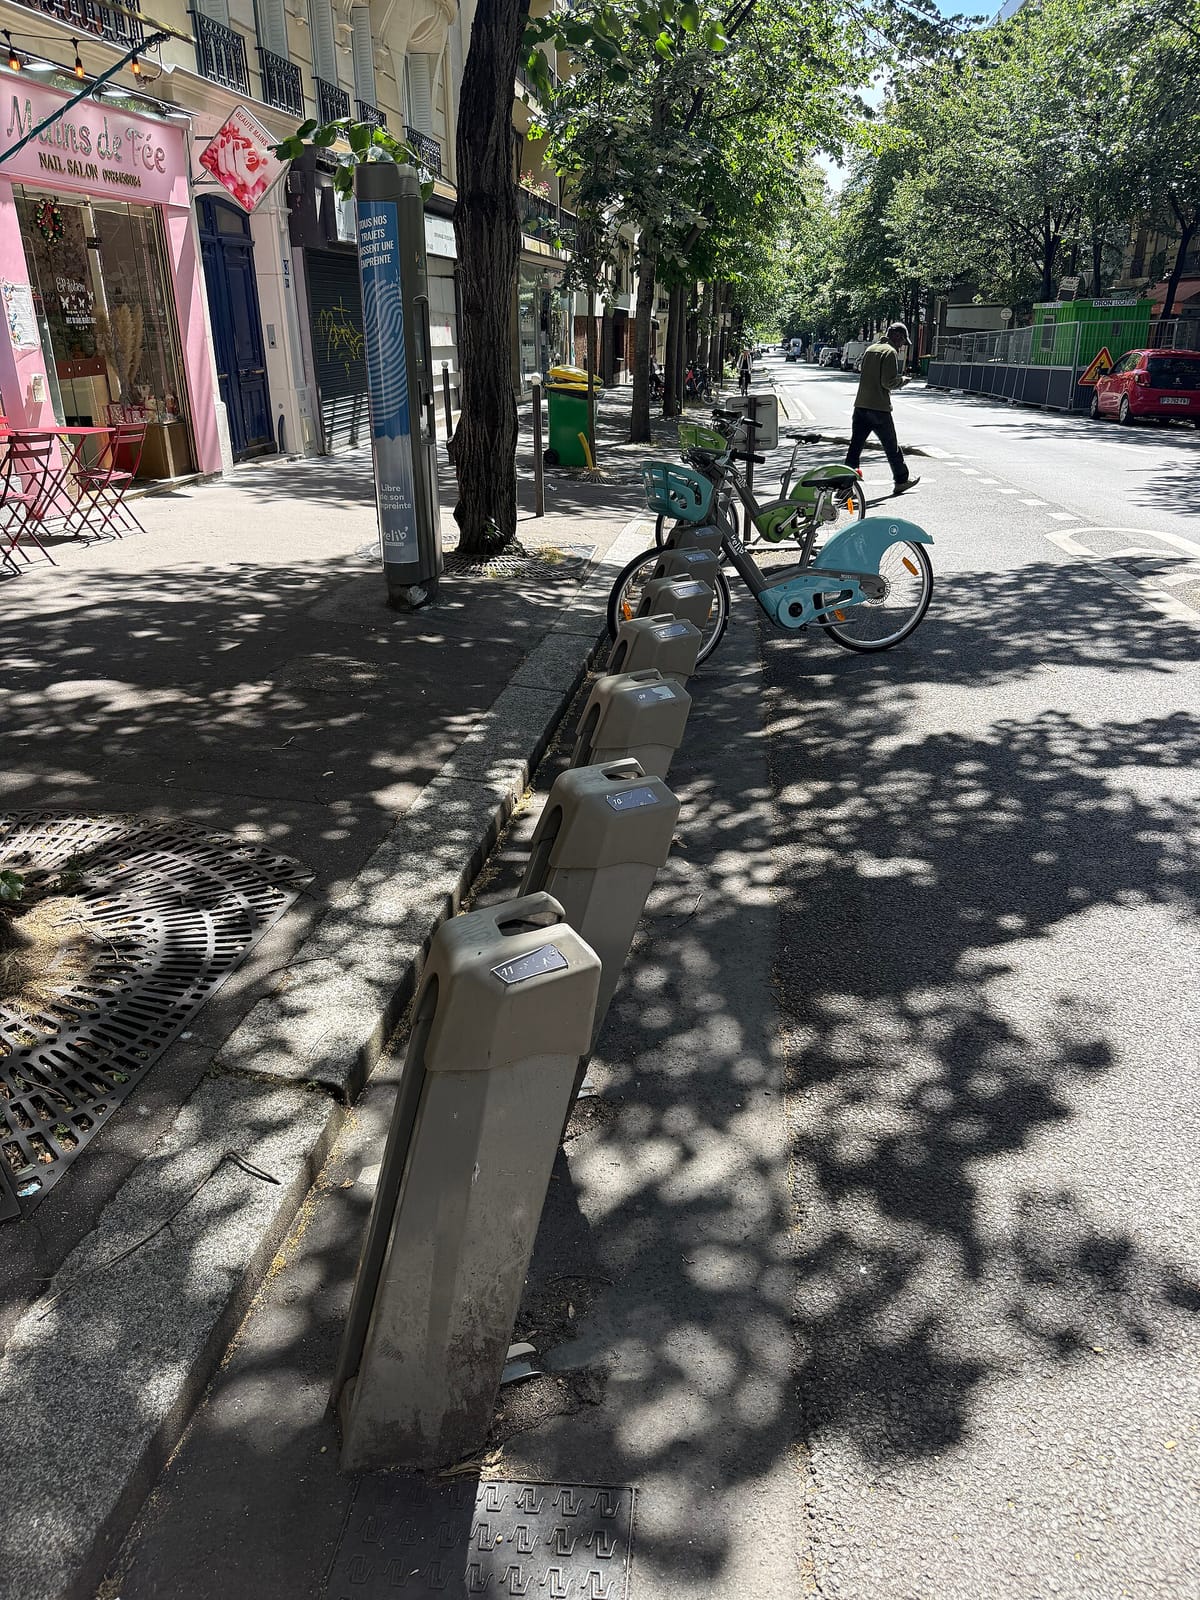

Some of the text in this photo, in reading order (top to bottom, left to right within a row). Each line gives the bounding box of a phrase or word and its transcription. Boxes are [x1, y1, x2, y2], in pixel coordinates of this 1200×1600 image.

[235, 111, 269, 147] BEAUTÉ MAINS
[98, 116, 123, 162] de
[125, 127, 166, 173] Fée
[38, 151, 65, 172] NAIL
[67, 159, 98, 181] SALON
[373, 214, 388, 226] NOS
[361, 228, 386, 242] TRAJETS
[381, 239, 394, 251] UNE
[381, 483, 401, 492] Libre
[613, 798, 623, 806] 10
